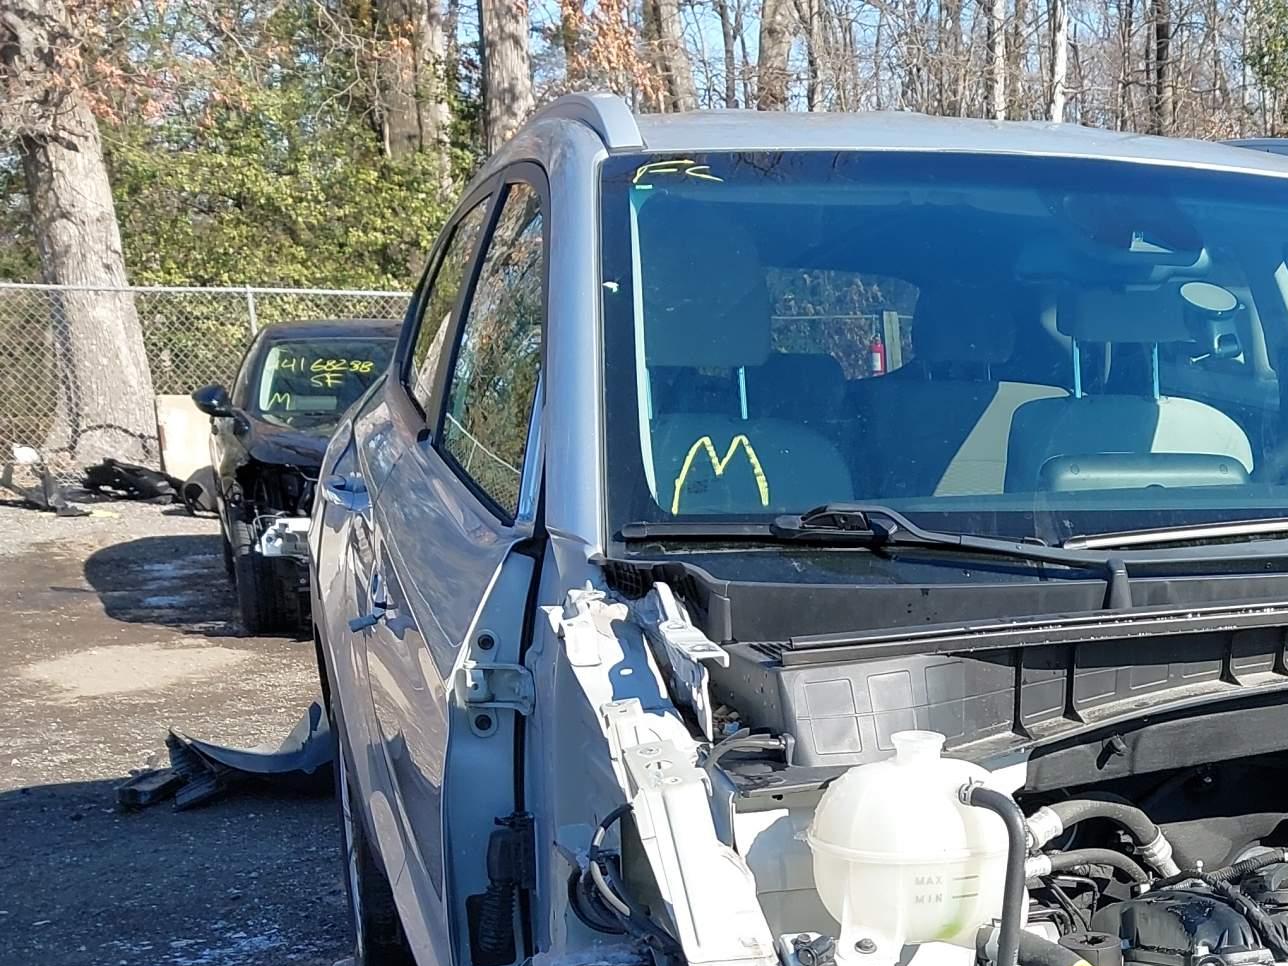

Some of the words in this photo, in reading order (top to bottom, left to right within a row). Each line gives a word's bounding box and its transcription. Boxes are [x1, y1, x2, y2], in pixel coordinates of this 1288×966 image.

[266, 393, 290, 411] M
[671, 434, 769, 515] M
[915, 876, 944, 886] MAX
[915, 893, 943, 905] MIN
